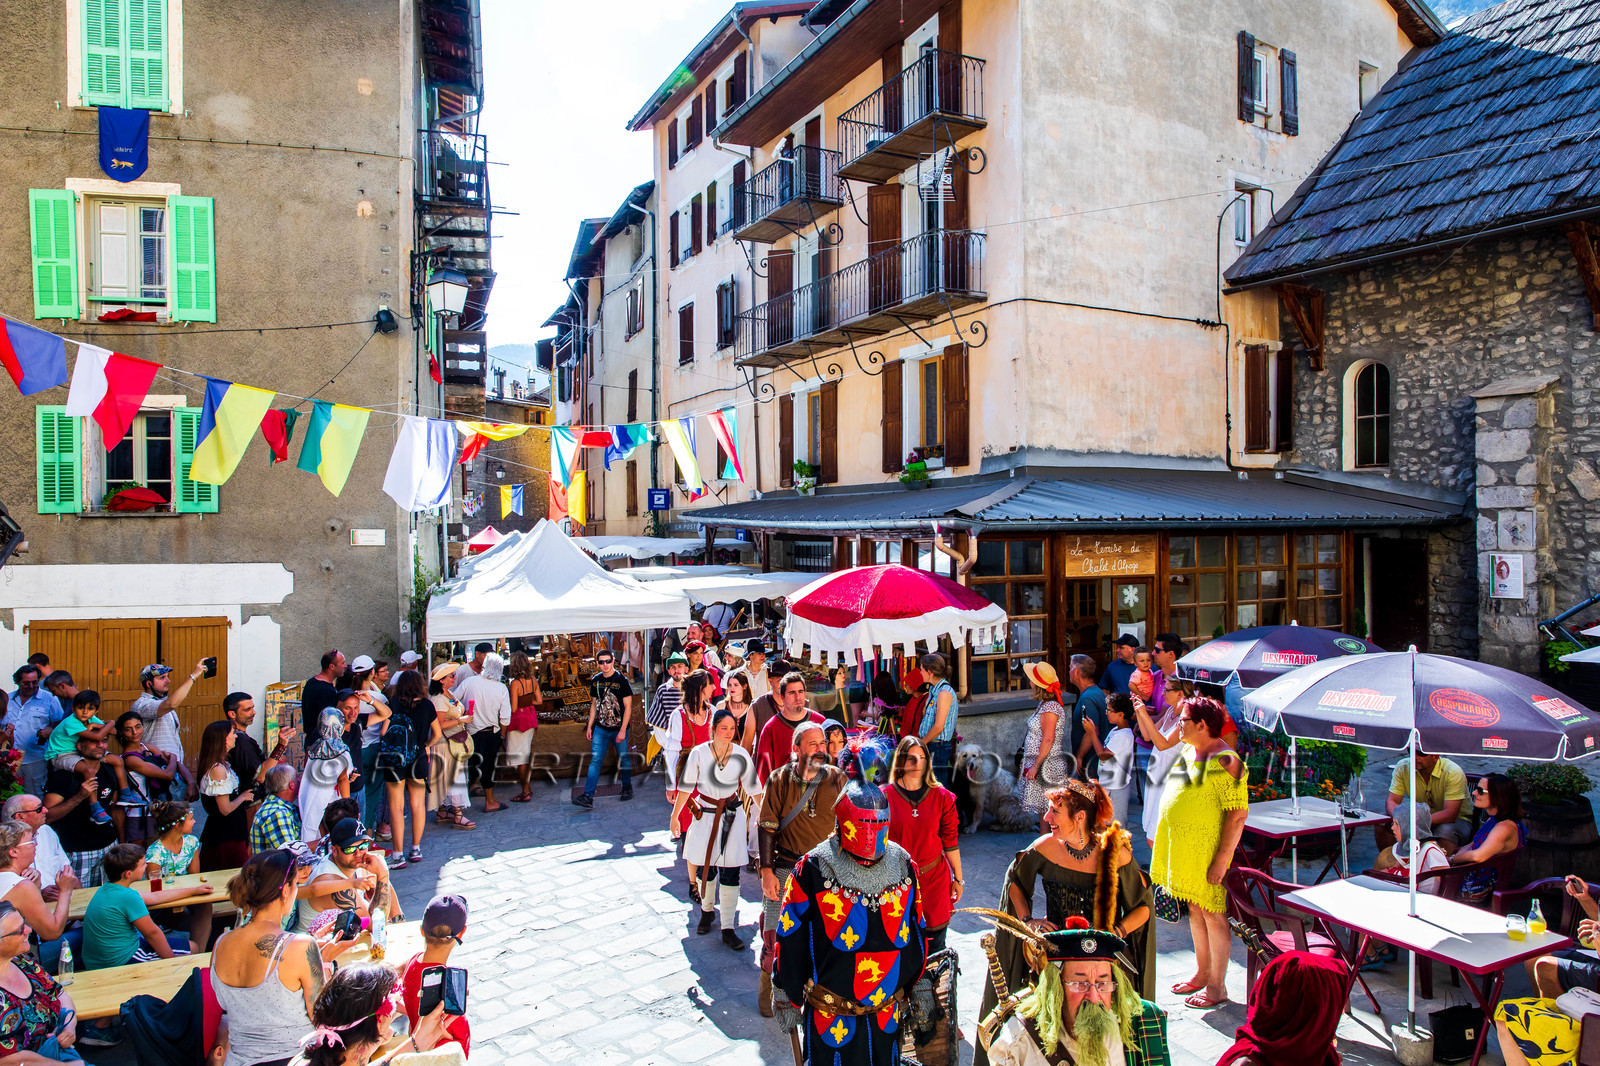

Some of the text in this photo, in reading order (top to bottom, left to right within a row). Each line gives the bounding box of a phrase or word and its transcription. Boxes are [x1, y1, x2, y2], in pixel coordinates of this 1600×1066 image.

[1070, 537, 1083, 556] La
[1131, 541, 1140, 553] du
[1082, 557, 1109, 574] Chalet
[402, 622, 407, 631] 6
[1262, 652, 1318, 665] DESPERADOS
[1319, 690, 1395, 712] DESPERADOS
[1436, 697, 1494, 718] DESPERADOS
